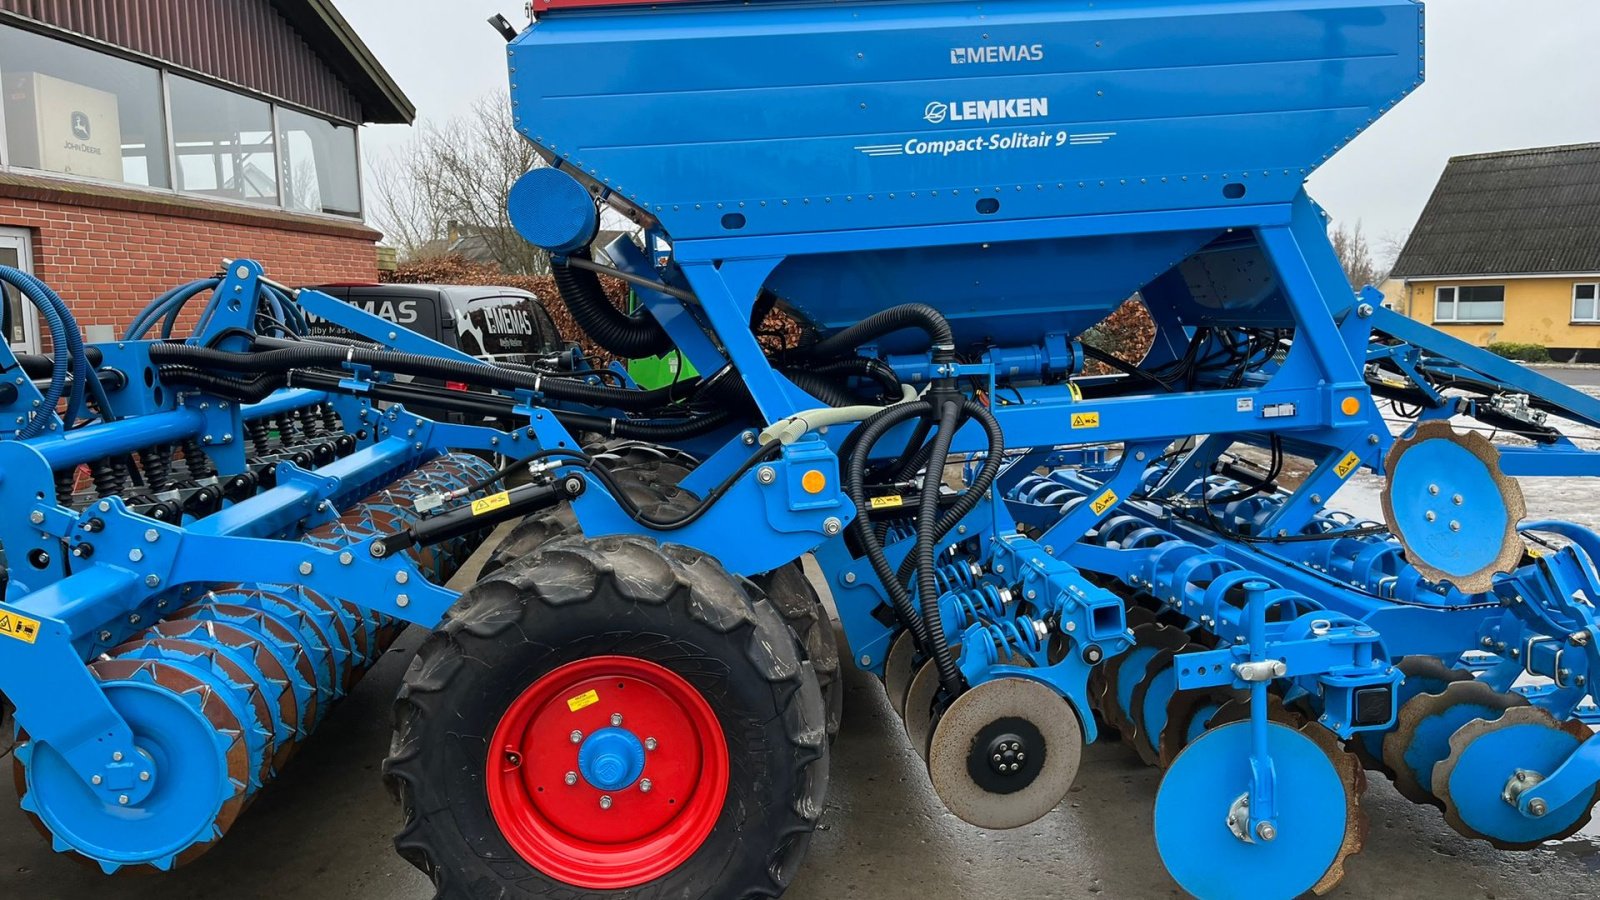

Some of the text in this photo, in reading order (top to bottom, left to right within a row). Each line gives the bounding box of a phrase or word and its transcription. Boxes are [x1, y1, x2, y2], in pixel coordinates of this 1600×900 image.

[967, 44, 1044, 63] MEMAS
[950, 97, 1048, 123] LEMKEN
[904, 131, 1067, 156] Compact-Solitair 9
[492, 307, 532, 335] MEMAS
